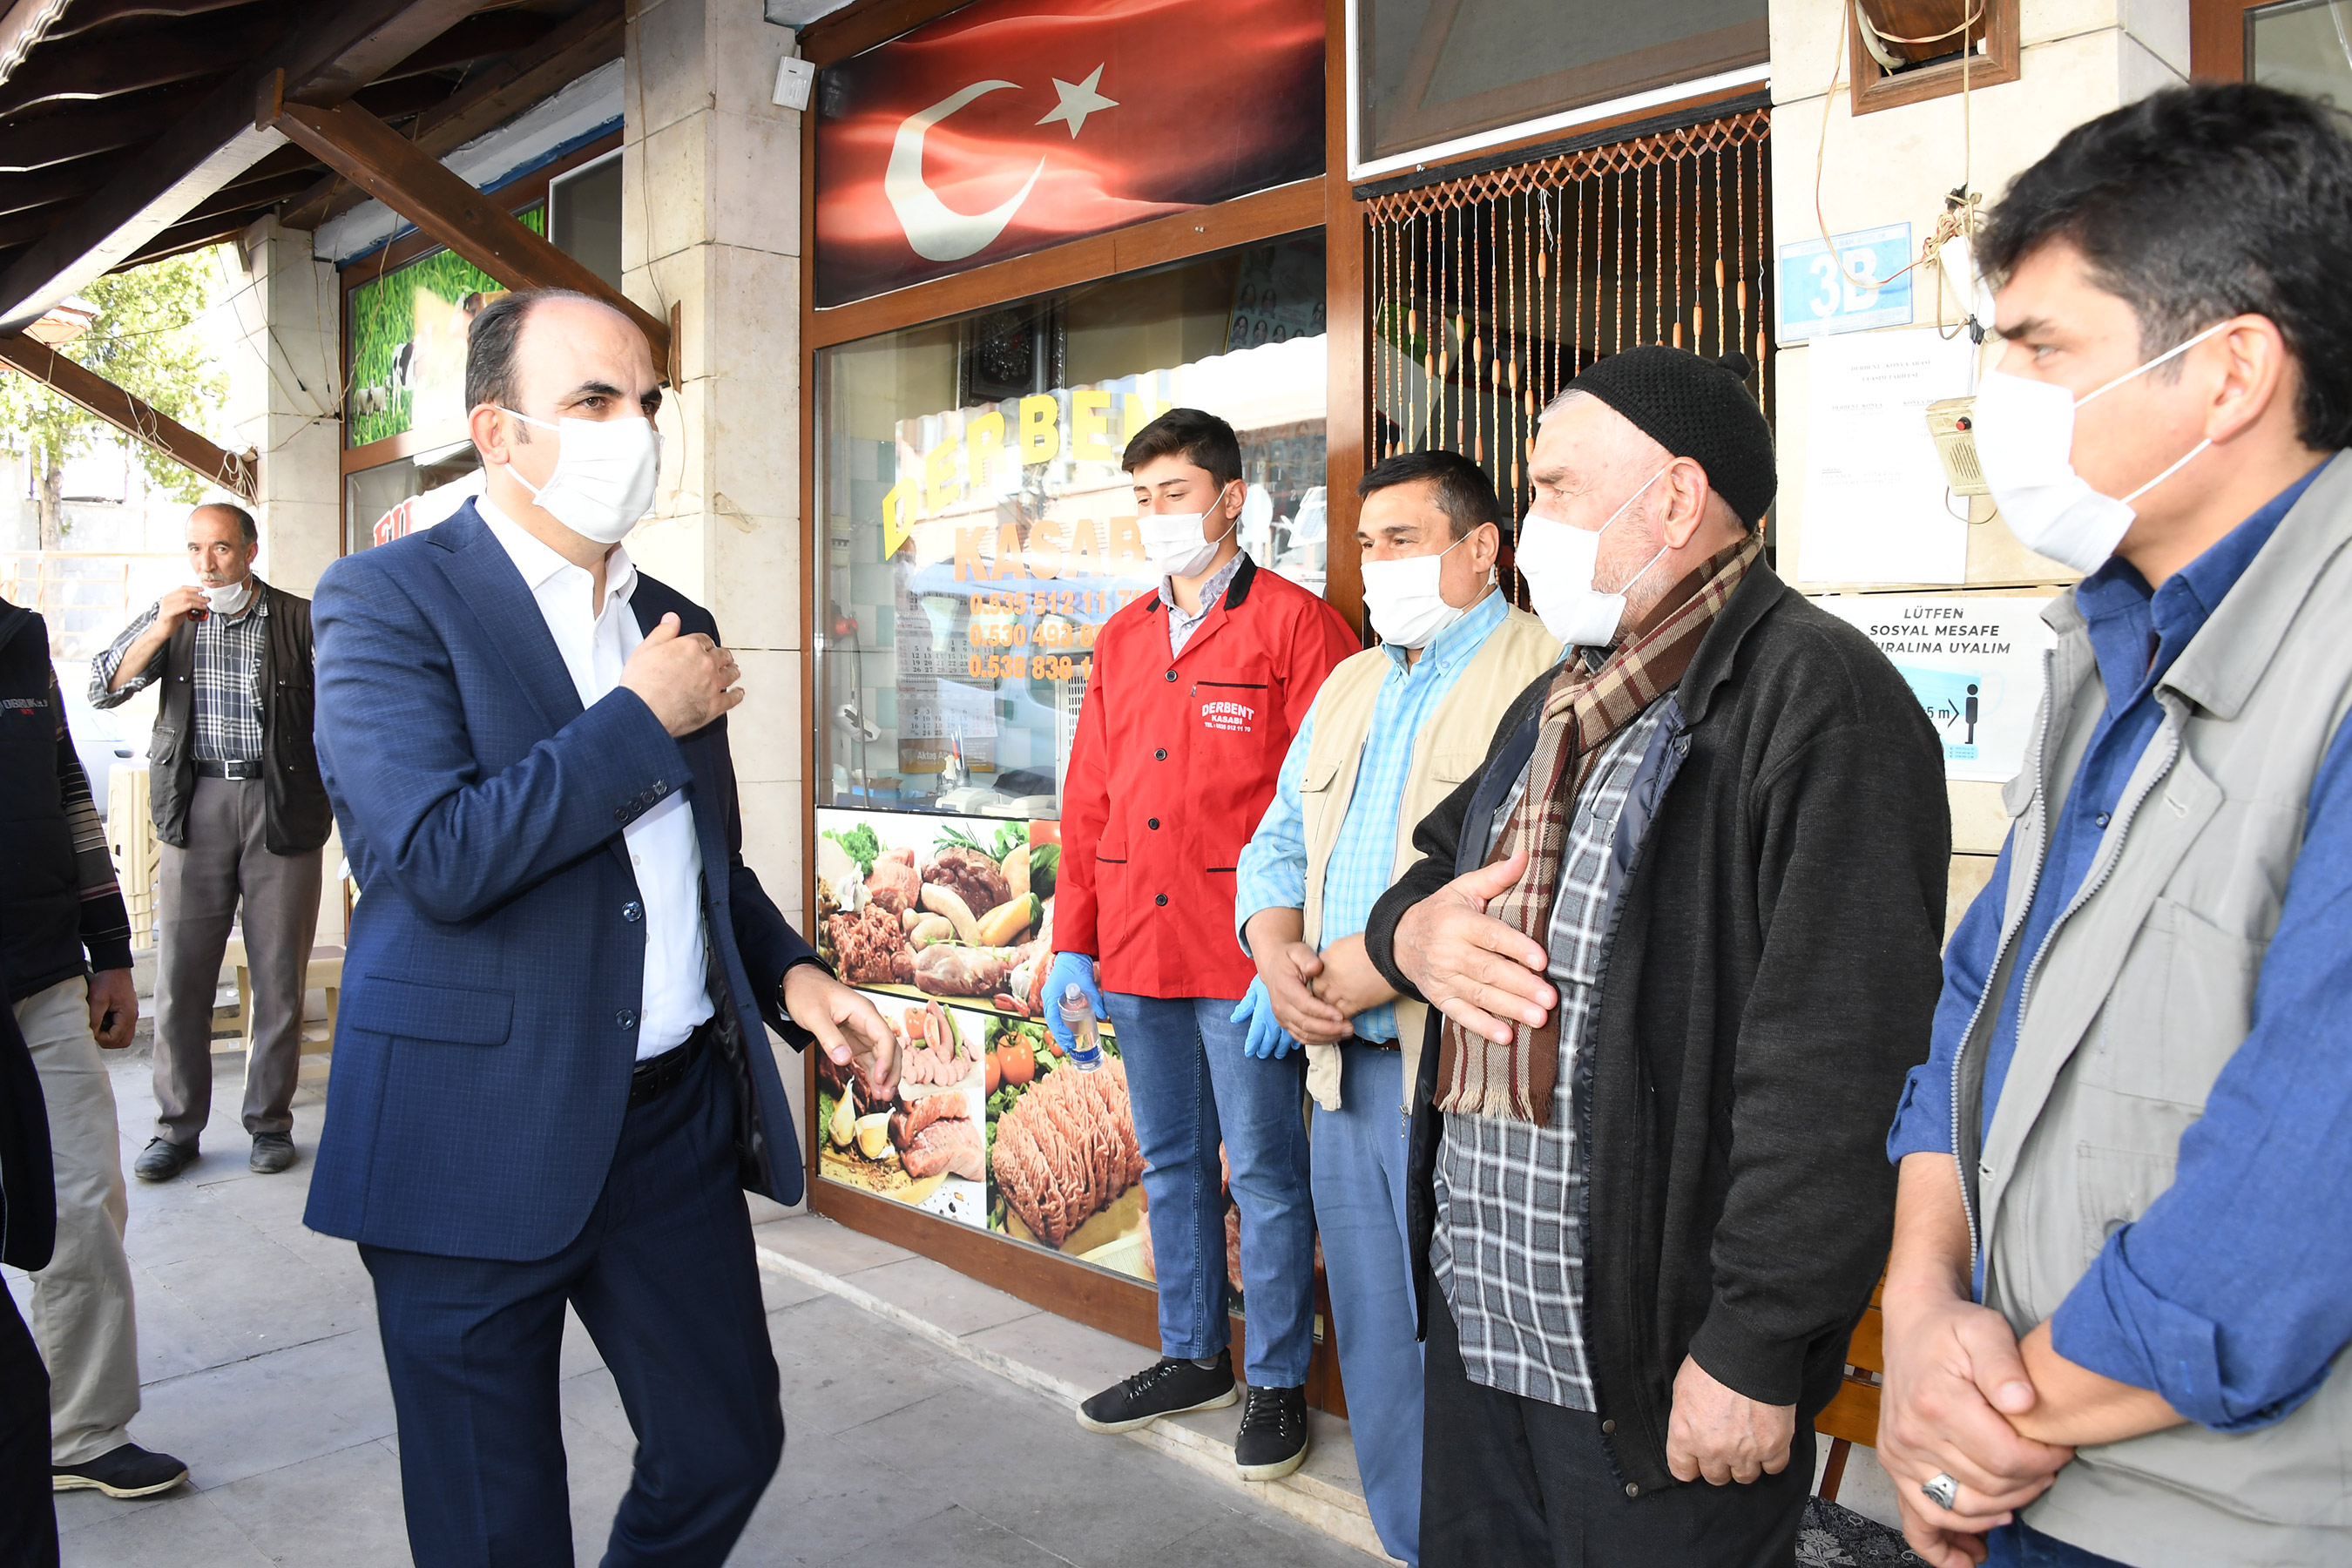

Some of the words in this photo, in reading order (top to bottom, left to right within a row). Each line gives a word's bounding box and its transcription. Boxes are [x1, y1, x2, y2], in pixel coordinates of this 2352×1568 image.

[1809, 247, 1879, 317] 3B
[882, 390, 1172, 561] DERBEN
[954, 516, 1147, 582] KASAB
[970, 591, 1027, 615] 0.535
[1033, 590, 1074, 615] 512
[1083, 590, 1105, 614] 11
[1903, 605, 1963, 618] LÜTFEN
[969, 623, 1027, 647] 0.530
[1031, 623, 1073, 648] 493
[1080, 623, 1105, 648] 8
[1869, 625, 1929, 636] SOSYAL
[1935, 625, 1999, 636] MESAFE
[1876, 642, 1943, 653] URALINA
[1950, 643, 2011, 654] UYALIM
[969, 655, 1026, 679] 0.538
[1031, 655, 1073, 679] 838
[1202, 701, 1254, 720] DERBENT
[1211, 714, 1243, 725] KASABI
